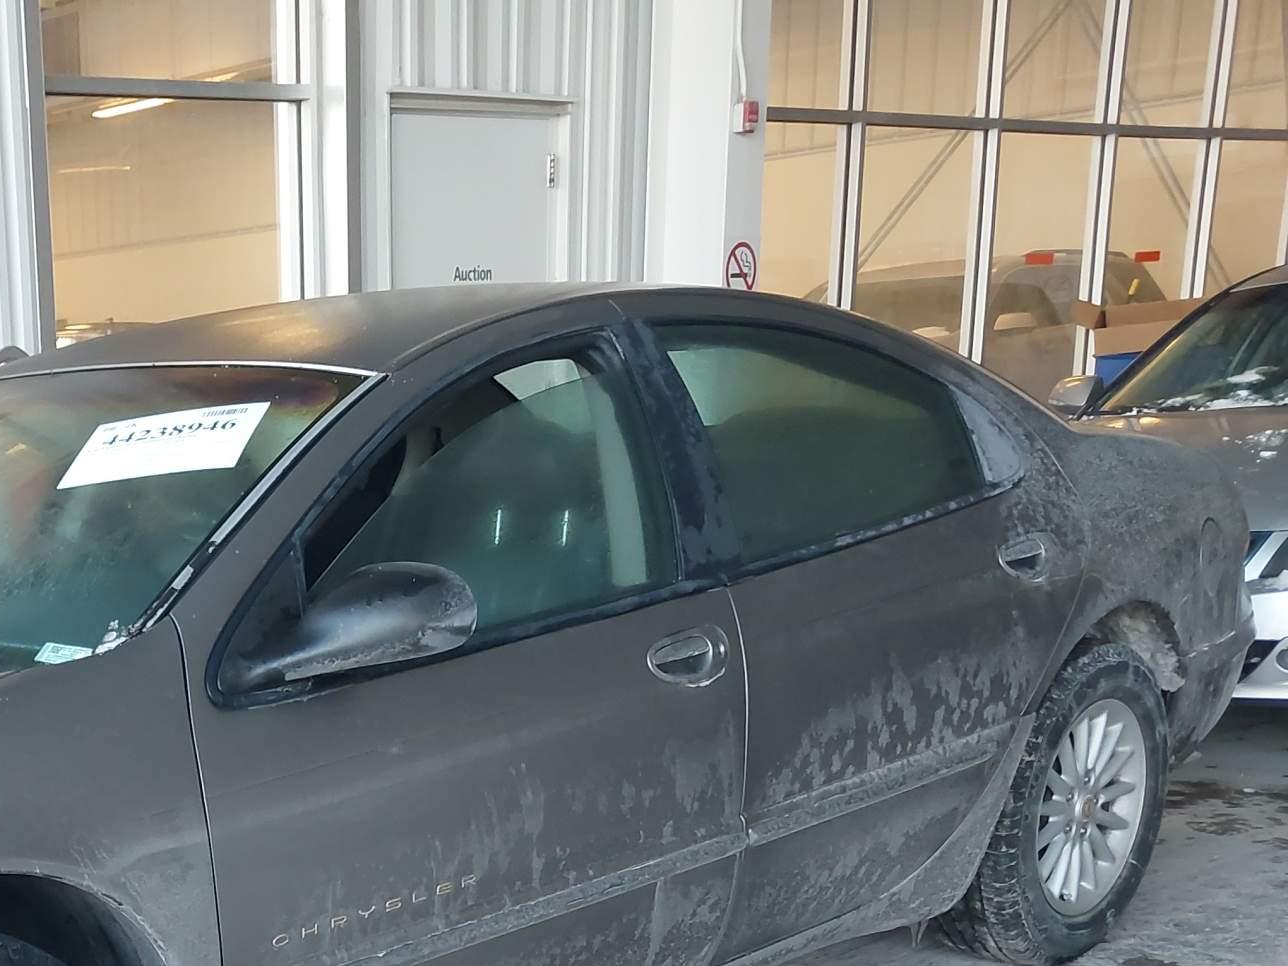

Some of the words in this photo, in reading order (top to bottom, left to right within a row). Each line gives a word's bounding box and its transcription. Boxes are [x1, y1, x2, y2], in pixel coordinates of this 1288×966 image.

[453, 264, 493, 281] Auction
[102, 418, 238, 445] 44238946
[272, 873, 479, 950] CHRYSLER
